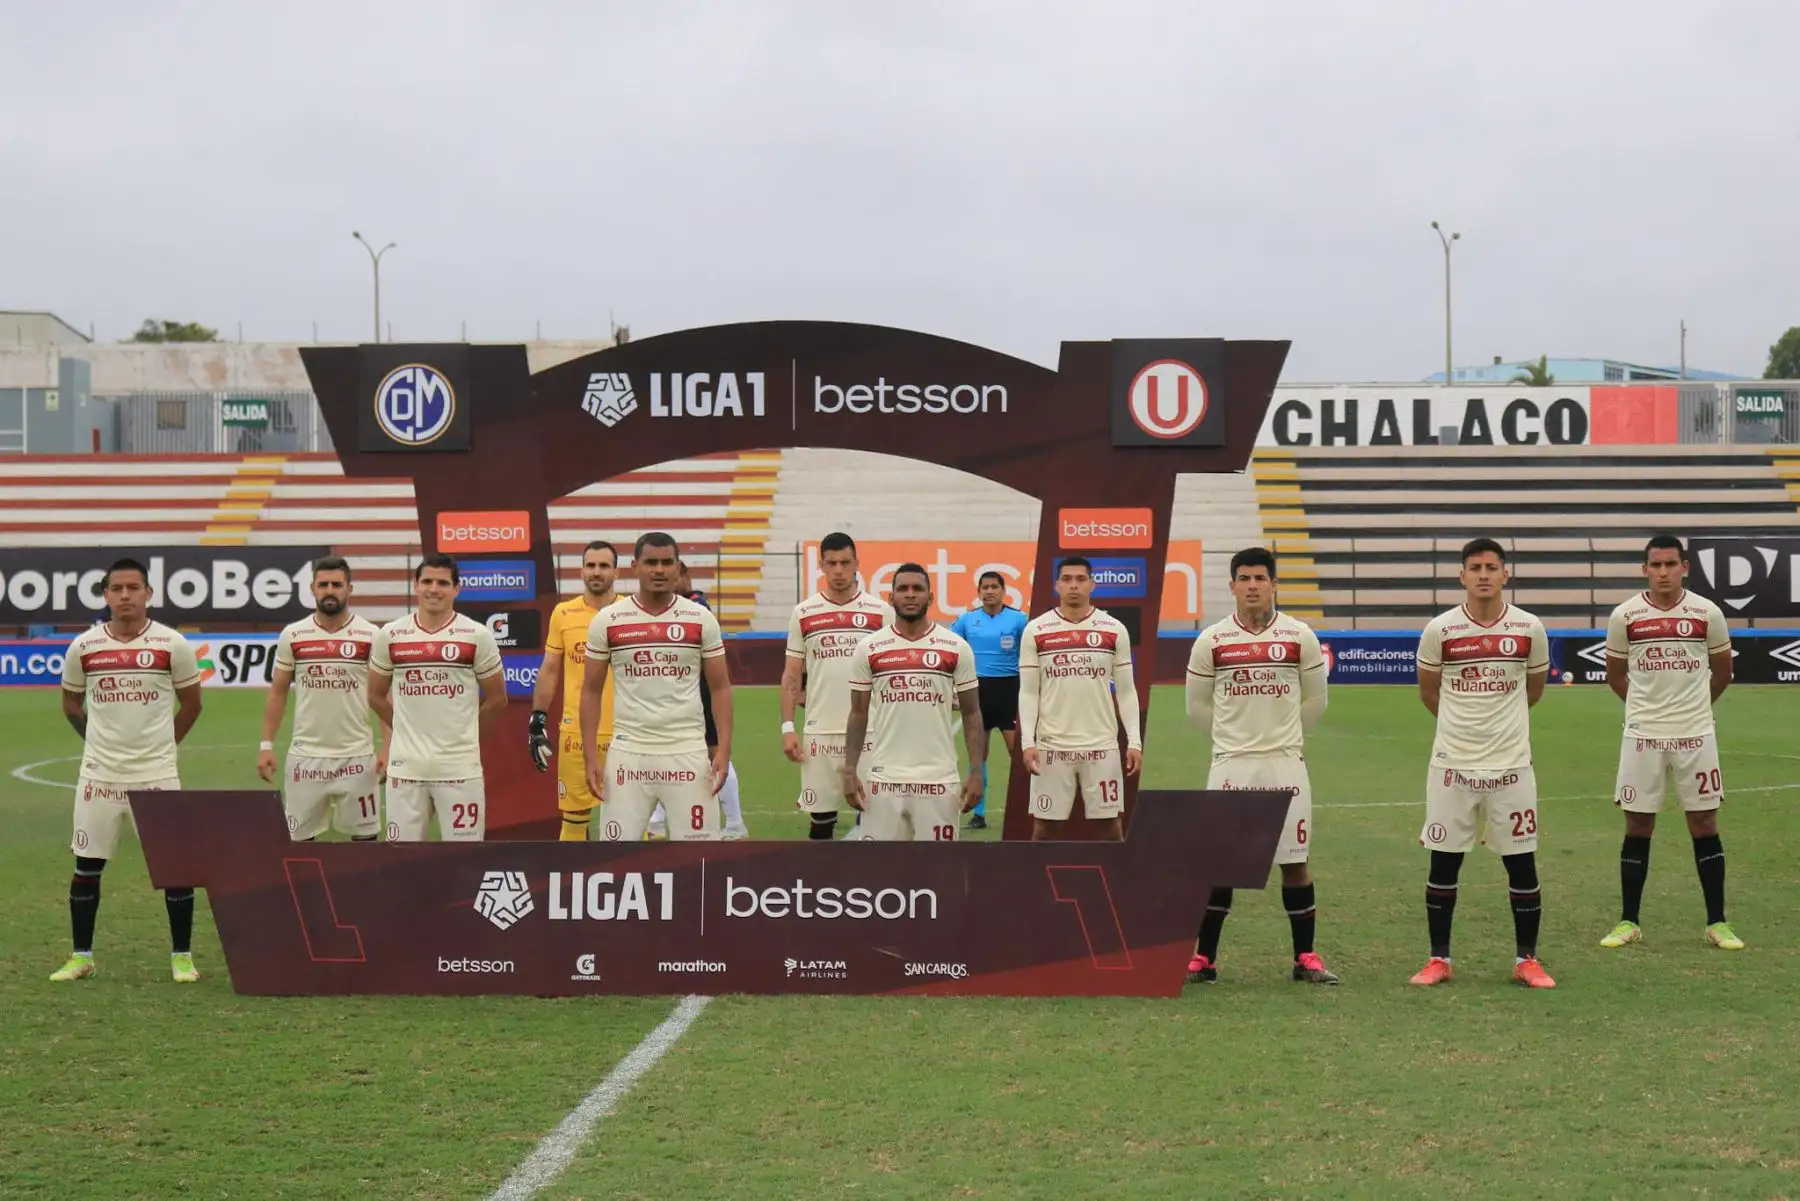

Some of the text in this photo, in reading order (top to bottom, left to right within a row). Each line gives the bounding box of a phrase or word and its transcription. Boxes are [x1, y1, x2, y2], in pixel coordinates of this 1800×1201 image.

[814, 376, 1007, 413] betsson
[1147, 375, 1188, 428] U
[222, 404, 268, 420] SALIDA
[1736, 396, 1784, 412] SALIDA
[1272, 398, 1588, 446] CHALACO
[442, 524, 525, 540] betsson
[1064, 520, 1148, 536] betsson
[458, 573, 524, 587] marathon
[837, 636, 858, 647] Caja
[654, 652, 678, 662] Caja
[1071, 654, 1092, 664] Caja
[1338, 648, 1415, 660] edificaciones
[1664, 648, 1687, 660] Caja
[325, 666, 346, 676] Caja
[624, 664, 691, 680] Huancayo
[1044, 666, 1106, 680] Huancayo
[1338, 664, 1415, 672] inmobiliarias
[1482, 666, 1506, 679] Caja
[1637, 658, 1700, 673] Huancayo
[118, 677, 142, 689] Caja
[302, 676, 359, 692] Huancayo
[425, 670, 448, 683] Caja
[909, 676, 932, 688] Caja
[1252, 670, 1276, 682] Caja
[399, 682, 464, 698] Huancayo
[1224, 682, 1290, 698] Huancayo
[1451, 679, 1518, 695] Huancayo
[93, 688, 158, 705] Huancayo
[1645, 738, 1704, 751] INMUNMED
[1054, 750, 1107, 762] INMUNIMED
[628, 770, 696, 782] INMUNIMED
[1454, 772, 1519, 790] INMUNIMED
[1696, 768, 1721, 795] 20
[880, 783, 946, 796] INMUNIMED
[1099, 780, 1119, 803] 13
[358, 793, 377, 818] 11
[452, 802, 479, 829] 29
[690, 804, 704, 831] 8
[1510, 808, 1537, 837] 23
[1296, 818, 1307, 844] 6
[726, 876, 938, 920] betsson
[438, 956, 514, 972] betsson
[658, 960, 726, 972] marathon
[800, 960, 847, 970] LATAM
[904, 962, 925, 976] SAN
